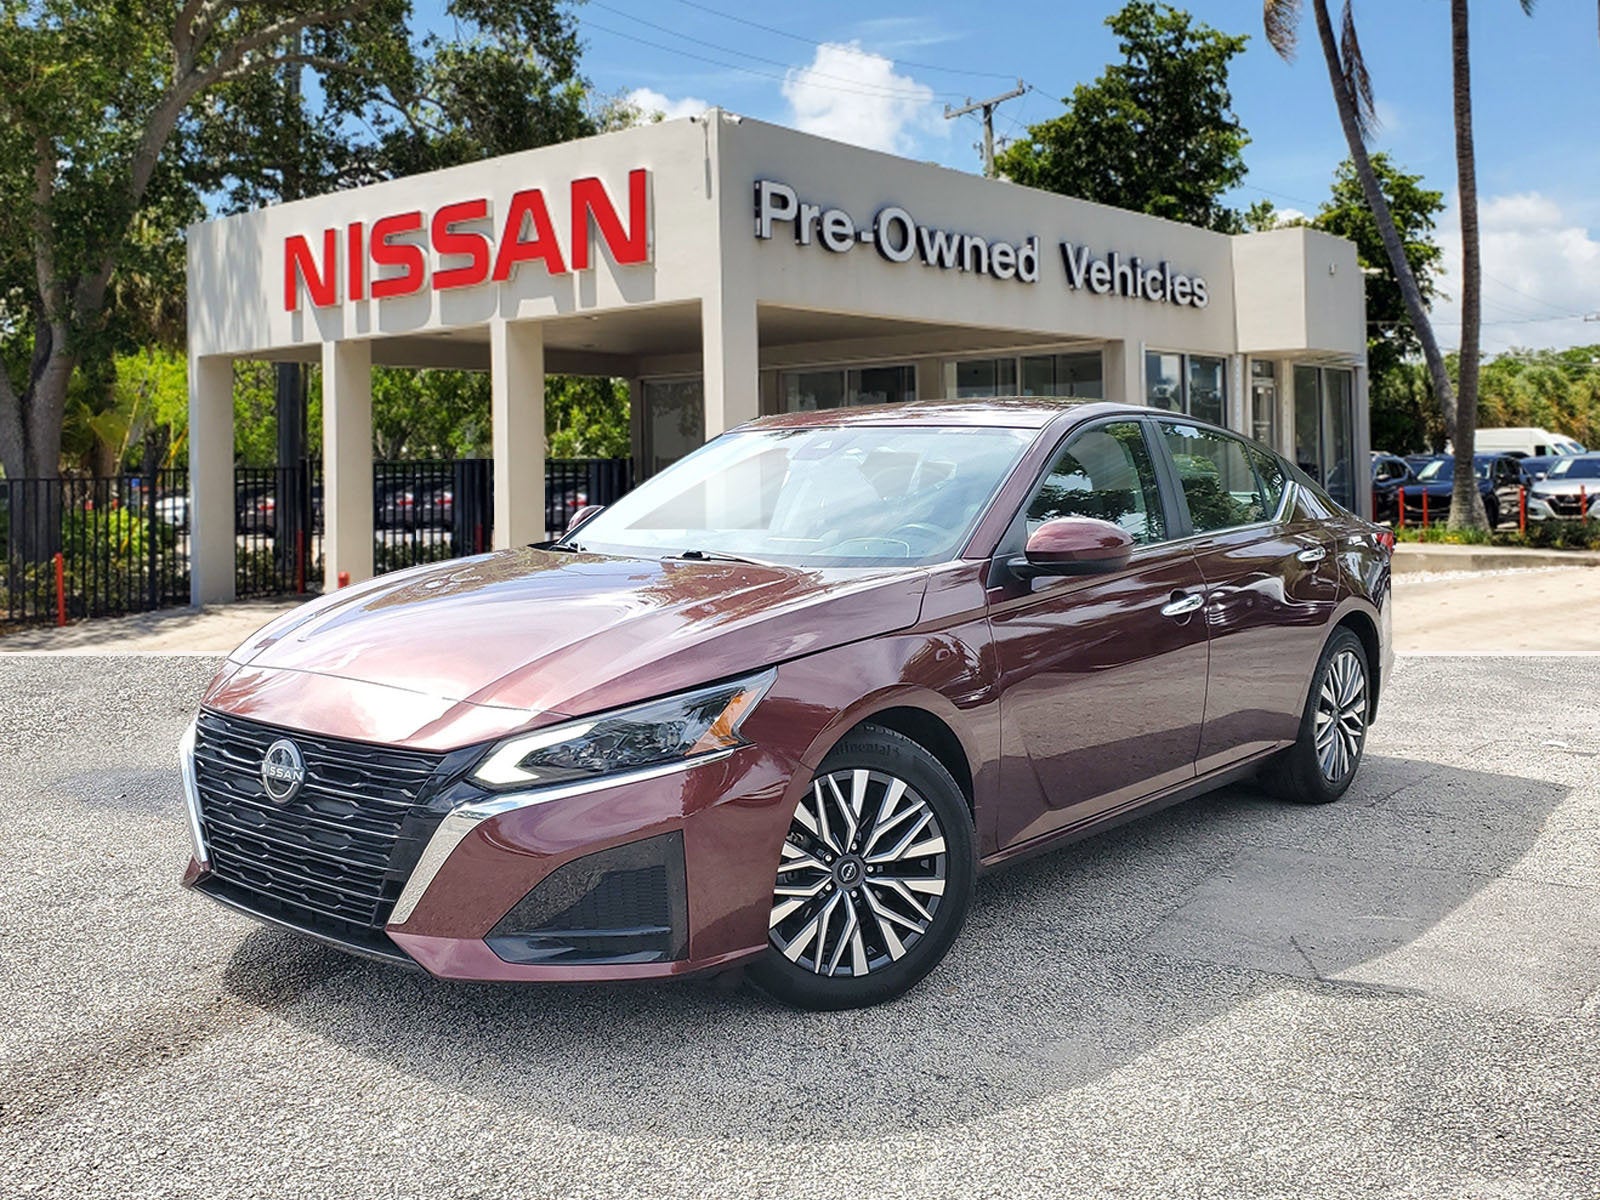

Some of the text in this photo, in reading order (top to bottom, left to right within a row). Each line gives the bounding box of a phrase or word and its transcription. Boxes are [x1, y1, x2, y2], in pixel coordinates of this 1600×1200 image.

[285, 167, 648, 312] NISSAN
[755, 179, 1209, 308] Pre-Owned Vehicles
